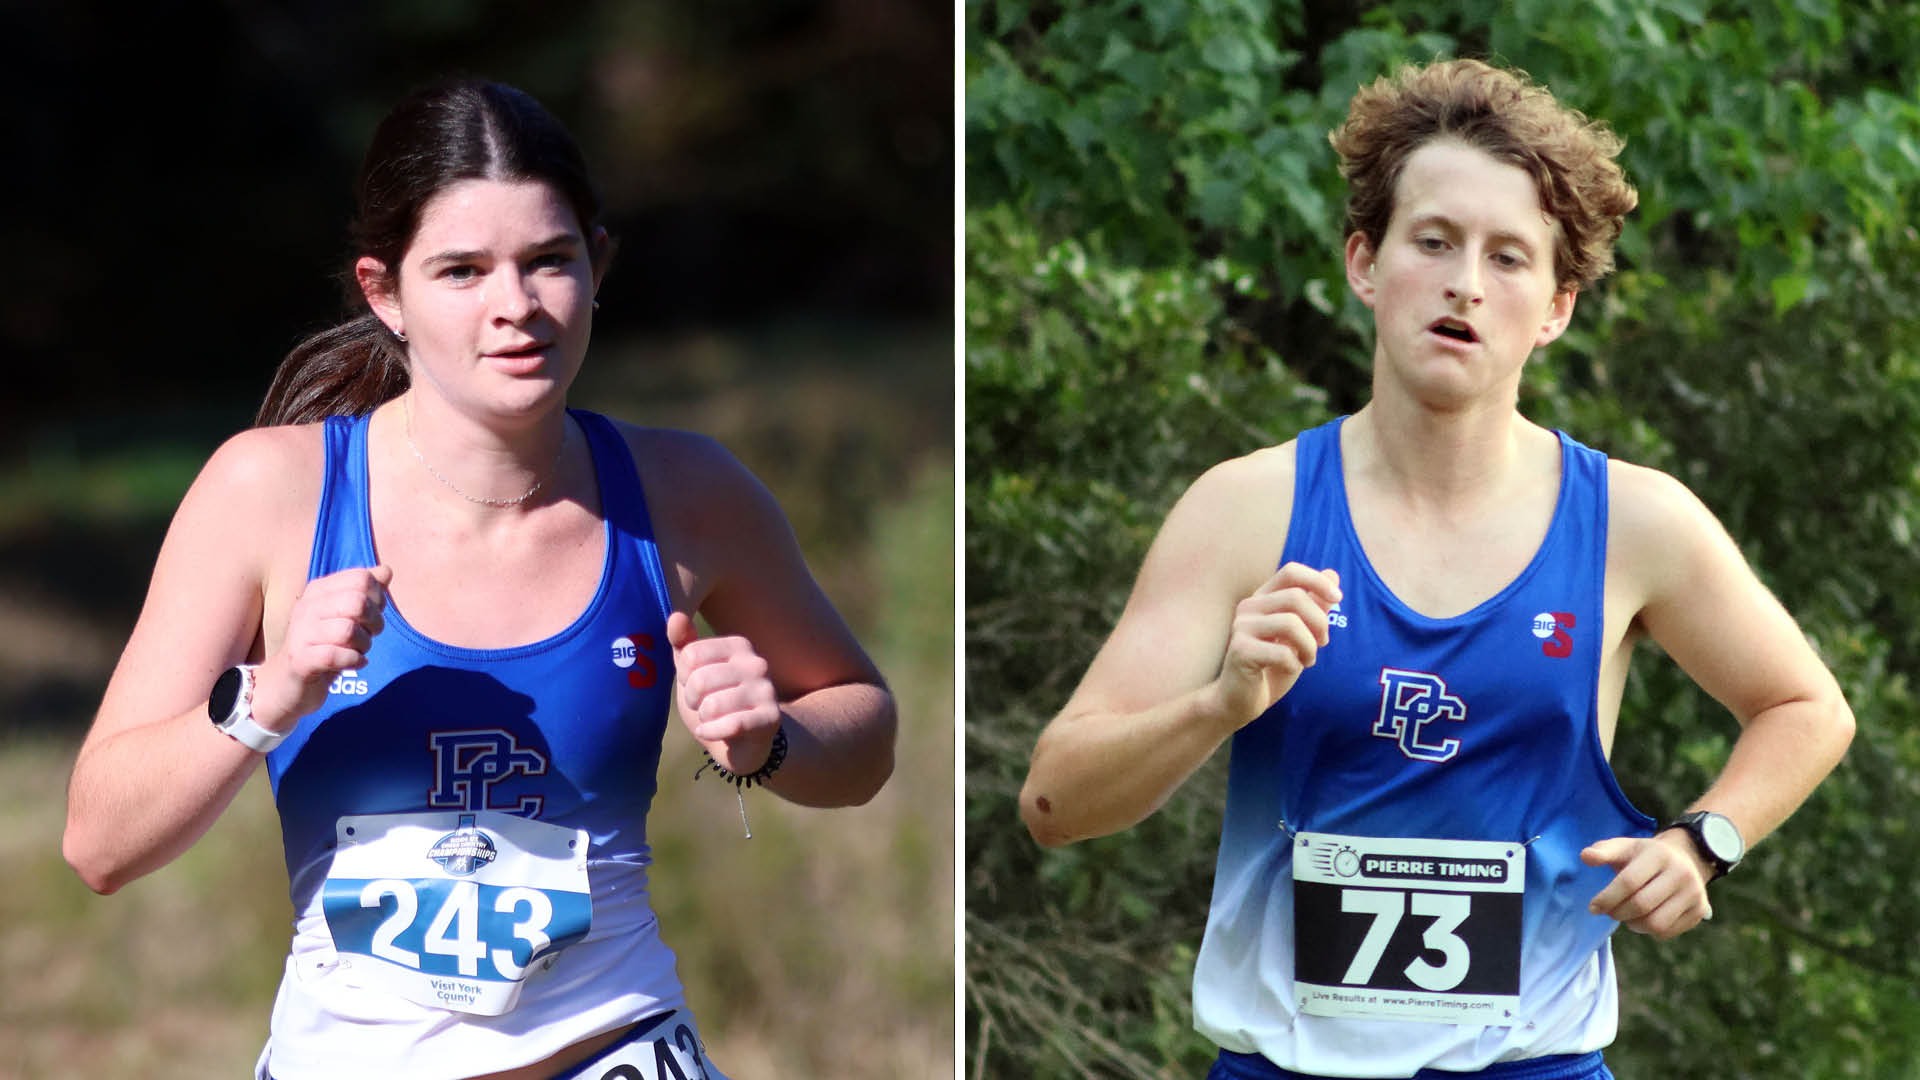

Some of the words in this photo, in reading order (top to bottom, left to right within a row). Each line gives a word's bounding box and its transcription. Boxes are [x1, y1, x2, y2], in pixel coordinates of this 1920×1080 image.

[328, 675, 369, 695] das
[428, 847, 496, 861] CHAMPIONSHIPS
[1366, 859, 1435, 875] PIERRE
[1438, 862, 1503, 878] TIMING
[360, 879, 553, 981] 243
[1341, 888, 1472, 992] 73
[430, 979, 455, 991] Visit
[458, 983, 482, 994] York
[437, 990, 475, 1005] County
[1333, 993, 1365, 1003] Results
[599, 1023, 711, 1080] 43
